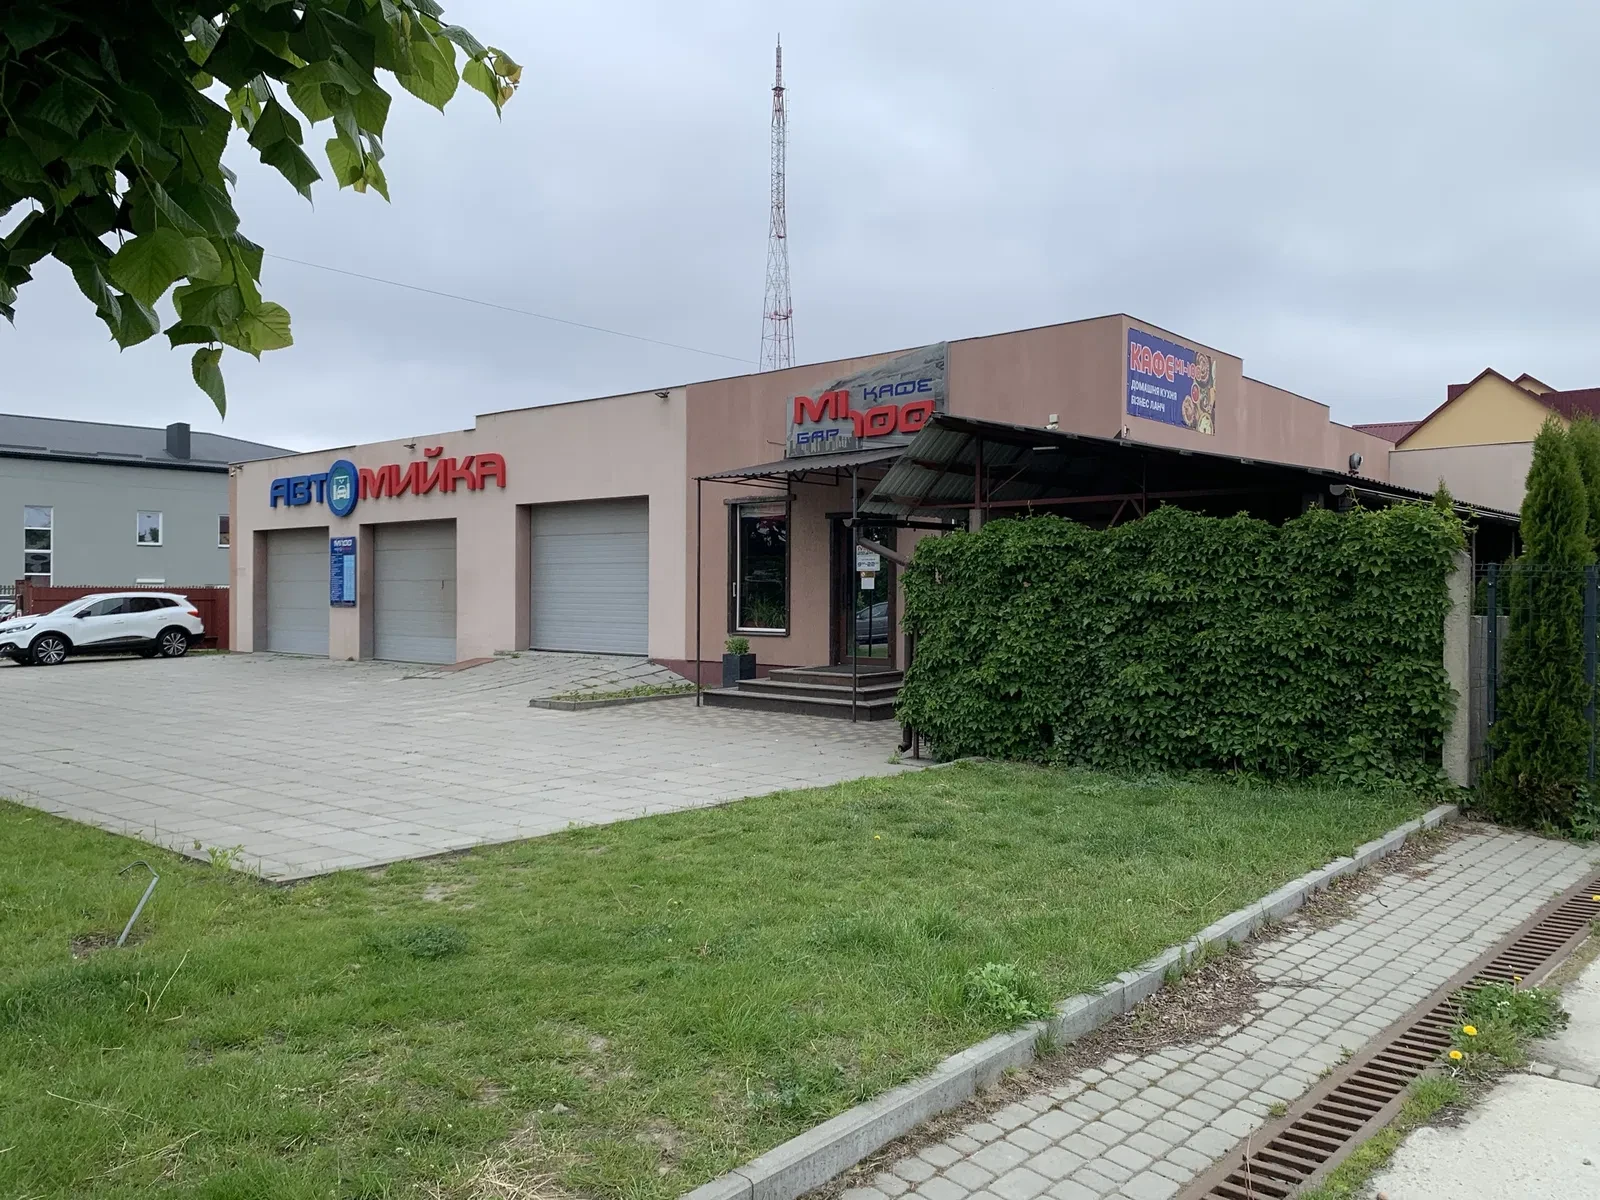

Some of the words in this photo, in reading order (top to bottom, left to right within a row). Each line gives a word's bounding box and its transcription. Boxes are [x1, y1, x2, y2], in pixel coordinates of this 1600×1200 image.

[1130, 341, 1175, 383] КАФЕ
[863, 378, 933, 402] КАФЕ
[1131, 379, 1160, 396] ДОМАШНЯ
[1160, 387, 1178, 401] КУХНЯ
[1131, 395, 1150, 408] БІЗНЕС
[1150, 400, 1166, 413] ЛАНЧ
[797, 428, 840, 445] БАР
